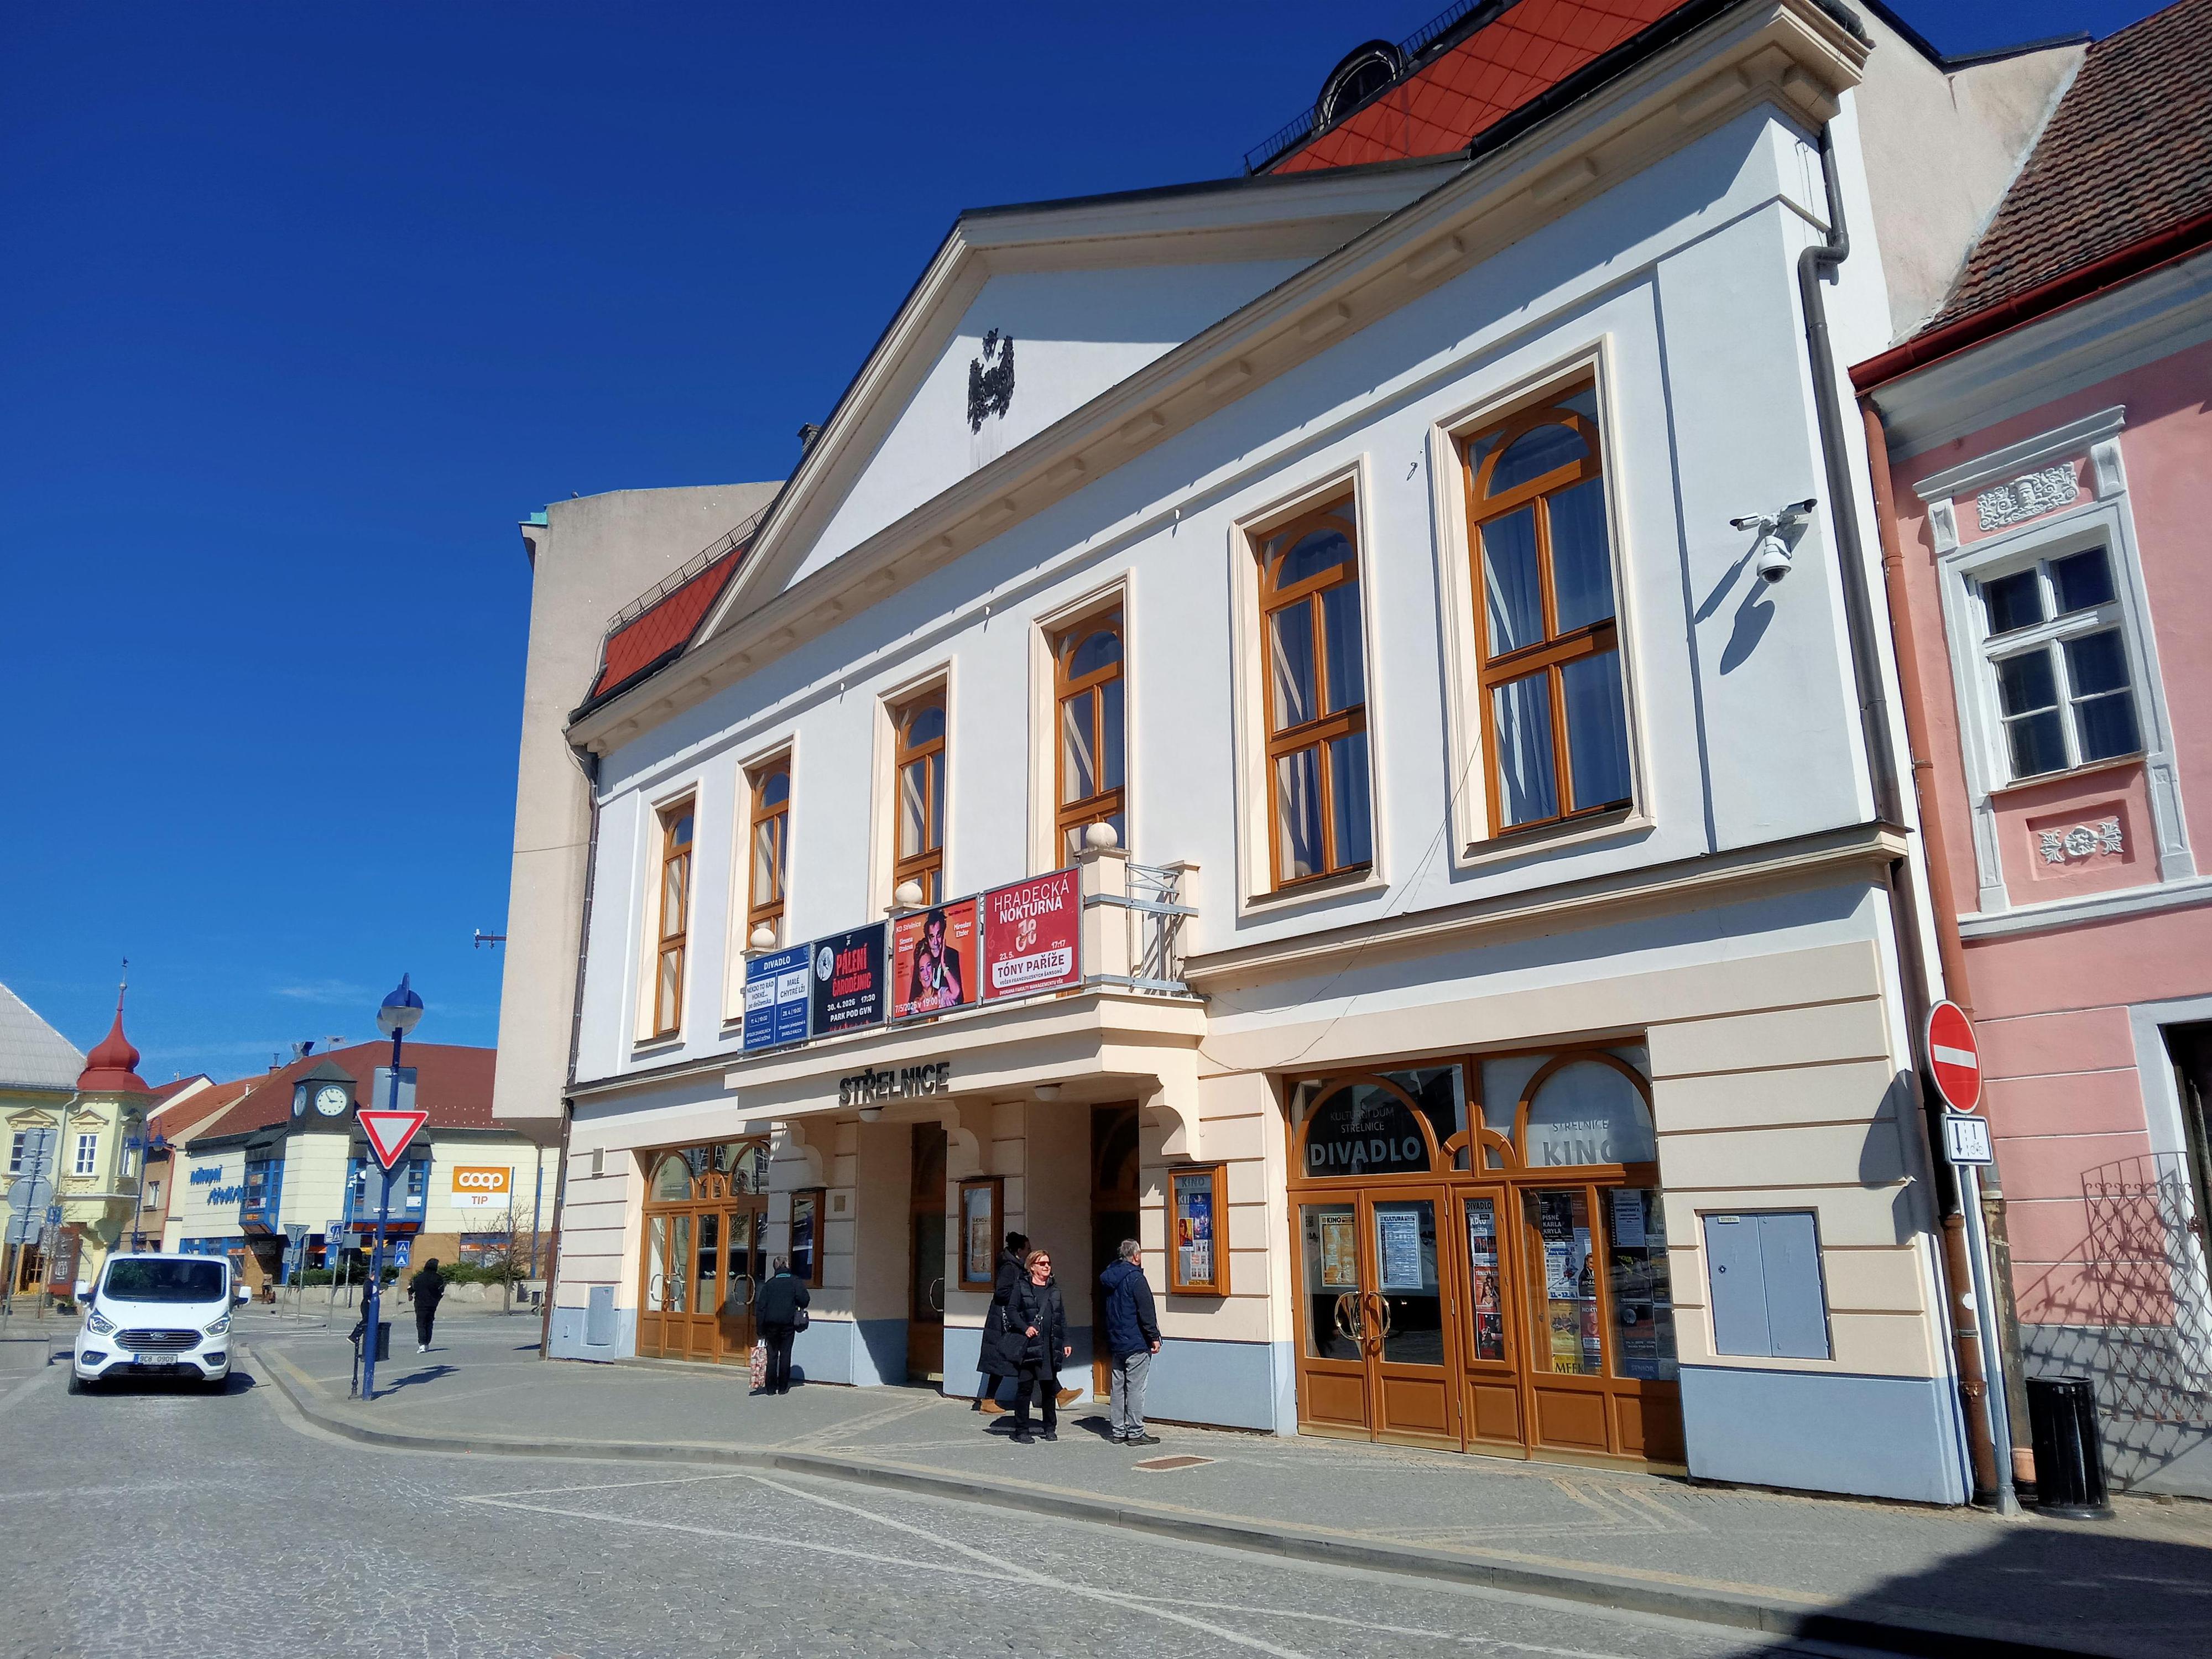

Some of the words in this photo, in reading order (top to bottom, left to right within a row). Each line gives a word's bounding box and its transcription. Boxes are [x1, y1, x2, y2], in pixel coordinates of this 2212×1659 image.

[994, 873, 1070, 912] HRADECKÁ
[1000, 896, 1063, 924] NOKTURNA
[1051, 940, 1066, 949] 17:17
[764, 956, 791, 971] DIVADLO
[836, 943, 868, 976] PÁLENÍ
[999, 952, 1008, 961] 23.
[998, 962, 1026, 978] TÓNY
[1026, 952, 1065, 972] PAŘÍŽE
[787, 975, 800, 987] MALÉ
[832, 972, 872, 997] ČARODĚJNIC
[780, 987, 798, 998] CHYTRÉ
[842, 999, 855, 1008] 2026
[860, 994, 876, 1003] 17:30
[830, 1011, 846, 1022] PARK
[846, 1009, 858, 1019] POD
[859, 1006, 872, 1015] GVN
[839, 1062, 950, 1104] STŘELNICE
[1310, 1136, 1421, 1166] DIVADLO
[458, 1172, 503, 1190] coop
[1182, 1177, 1204, 1187] KINO
[471, 1196, 488, 1204] TIP
